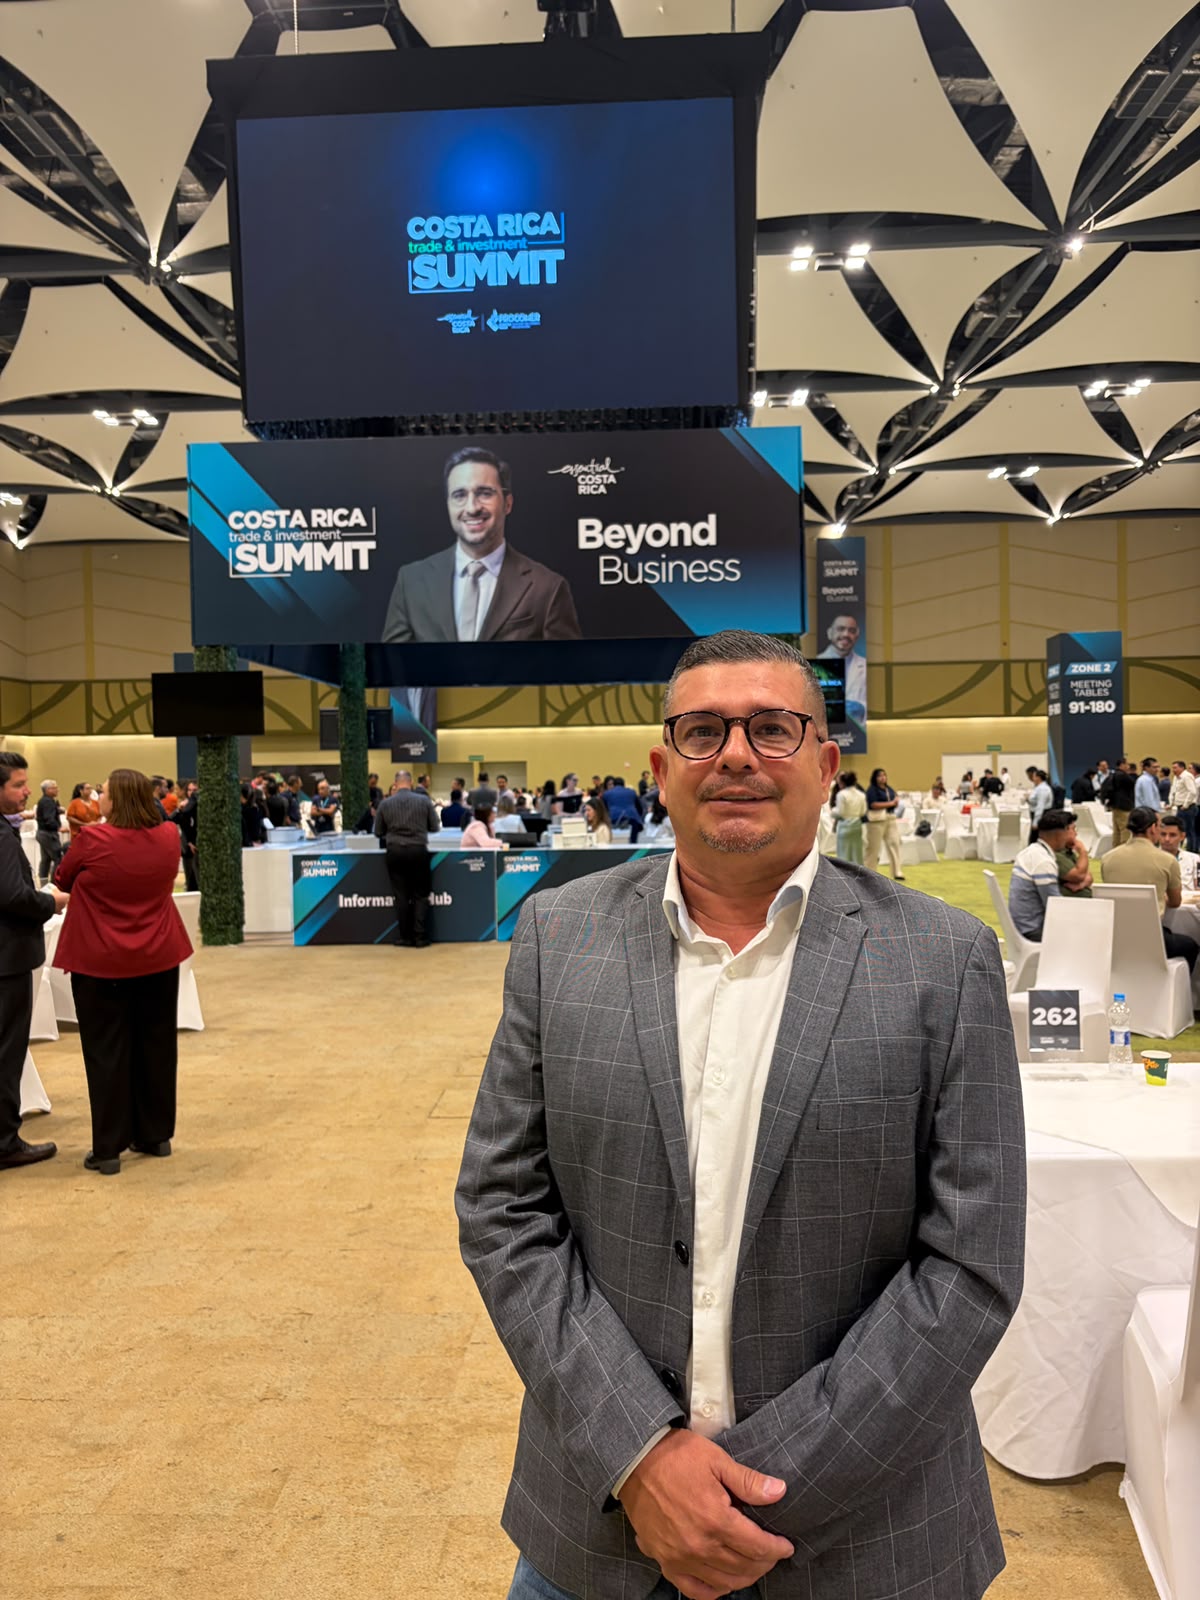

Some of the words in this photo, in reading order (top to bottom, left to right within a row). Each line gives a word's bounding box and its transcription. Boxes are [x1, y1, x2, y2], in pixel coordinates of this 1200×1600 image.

[407, 214, 493, 240] COSTA
[497, 211, 560, 236] RICA
[408, 240, 442, 254] trade
[445, 239, 455, 252] &
[457, 237, 528, 251] investment
[413, 249, 565, 289] SUMMIT
[577, 474, 617, 485] COSTA
[577, 484, 607, 495] RICA
[228, 509, 308, 530] COSTA
[311, 507, 367, 528] RICA
[229, 530, 261, 542] trade
[263, 529, 273, 542] &
[275, 528, 341, 541] investment
[578, 514, 717, 554] Beyond
[235, 541, 376, 573] SUMMIT
[599, 554, 741, 585] Business
[1071, 664, 1102, 673] ZONE
[1103, 663, 1112, 672] 2
[1070, 679, 1112, 689] MEETING
[1073, 688, 1110, 697] TABLES
[1068, 700, 1116, 714] 91-180
[302, 867, 338, 877] SUMMIT
[505, 863, 540, 873] SUMMIT
[338, 893, 396, 908] Informa
[1032, 1007, 1077, 1026] 262
